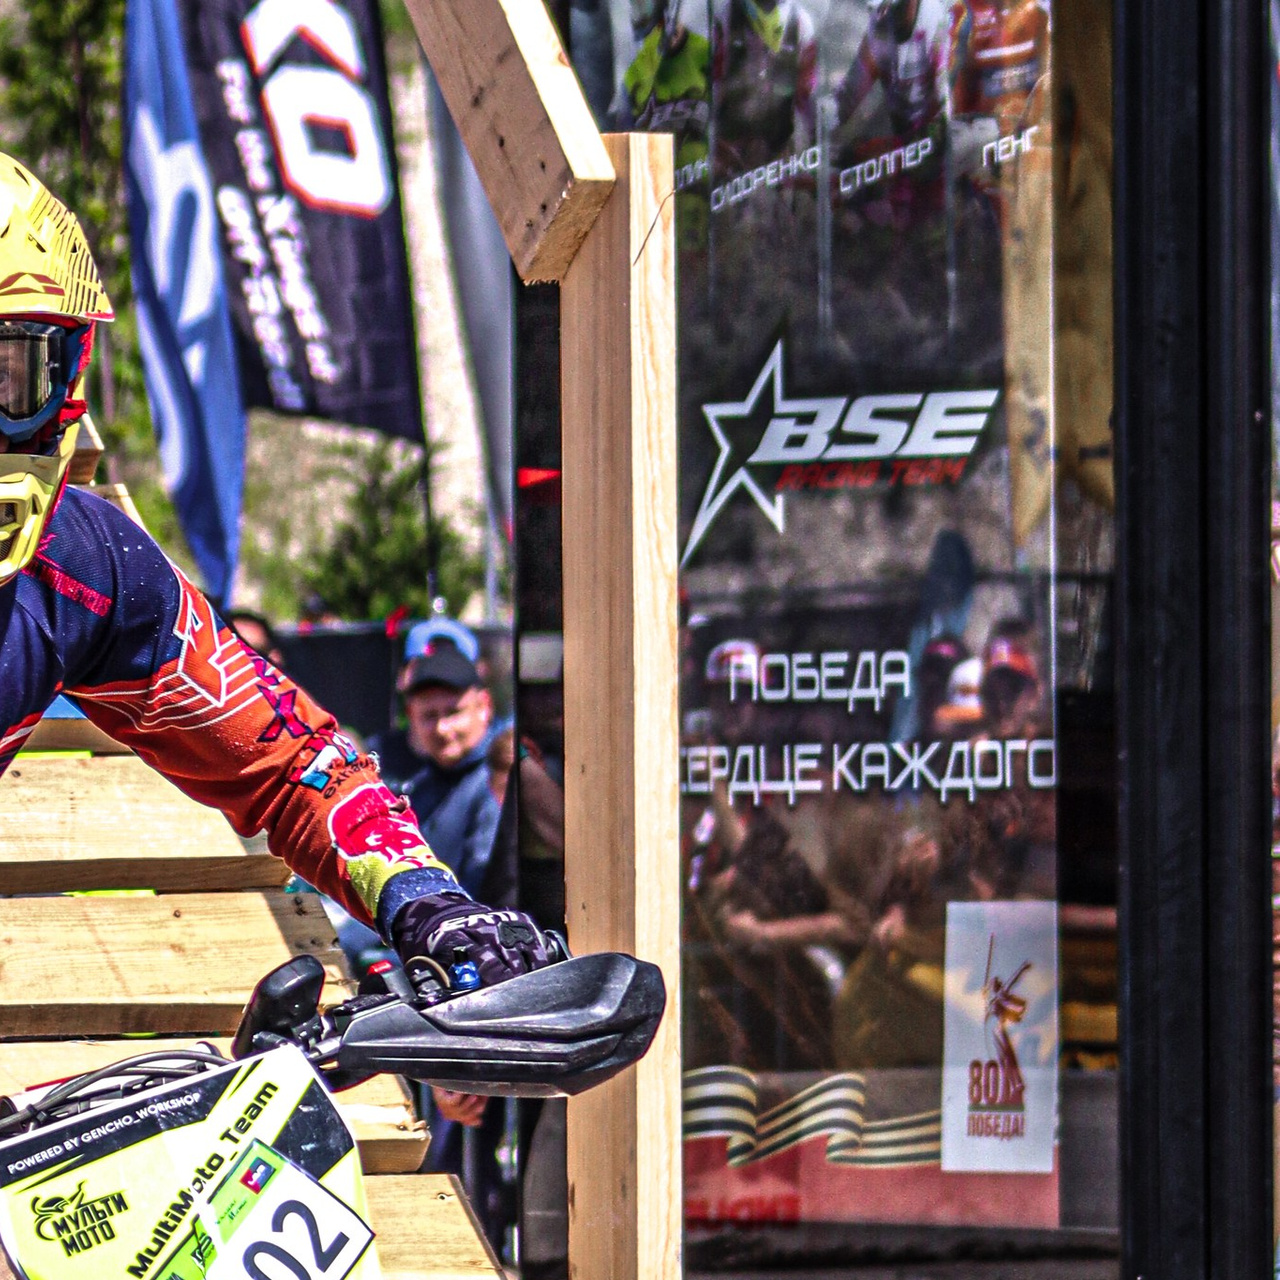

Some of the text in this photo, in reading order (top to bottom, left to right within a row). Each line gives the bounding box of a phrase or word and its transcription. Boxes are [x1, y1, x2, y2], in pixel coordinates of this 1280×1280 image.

[839, 136, 934, 195] СТОЛПЕР
[747, 389, 1000, 463] BSE
[774, 456, 969, 491] RACING TEAM
[728, 650, 912, 713] ПОБЕДА
[832, 738, 1057, 803] КАЖДОГО
[969, 1060, 1000, 1105] 80
[7, 1144, 64, 1175] POWERED
[63, 1136, 81, 1152] BY
[51, 1191, 129, 1239] МУЛЬТИ
[60, 1219, 116, 1257] МОТО
